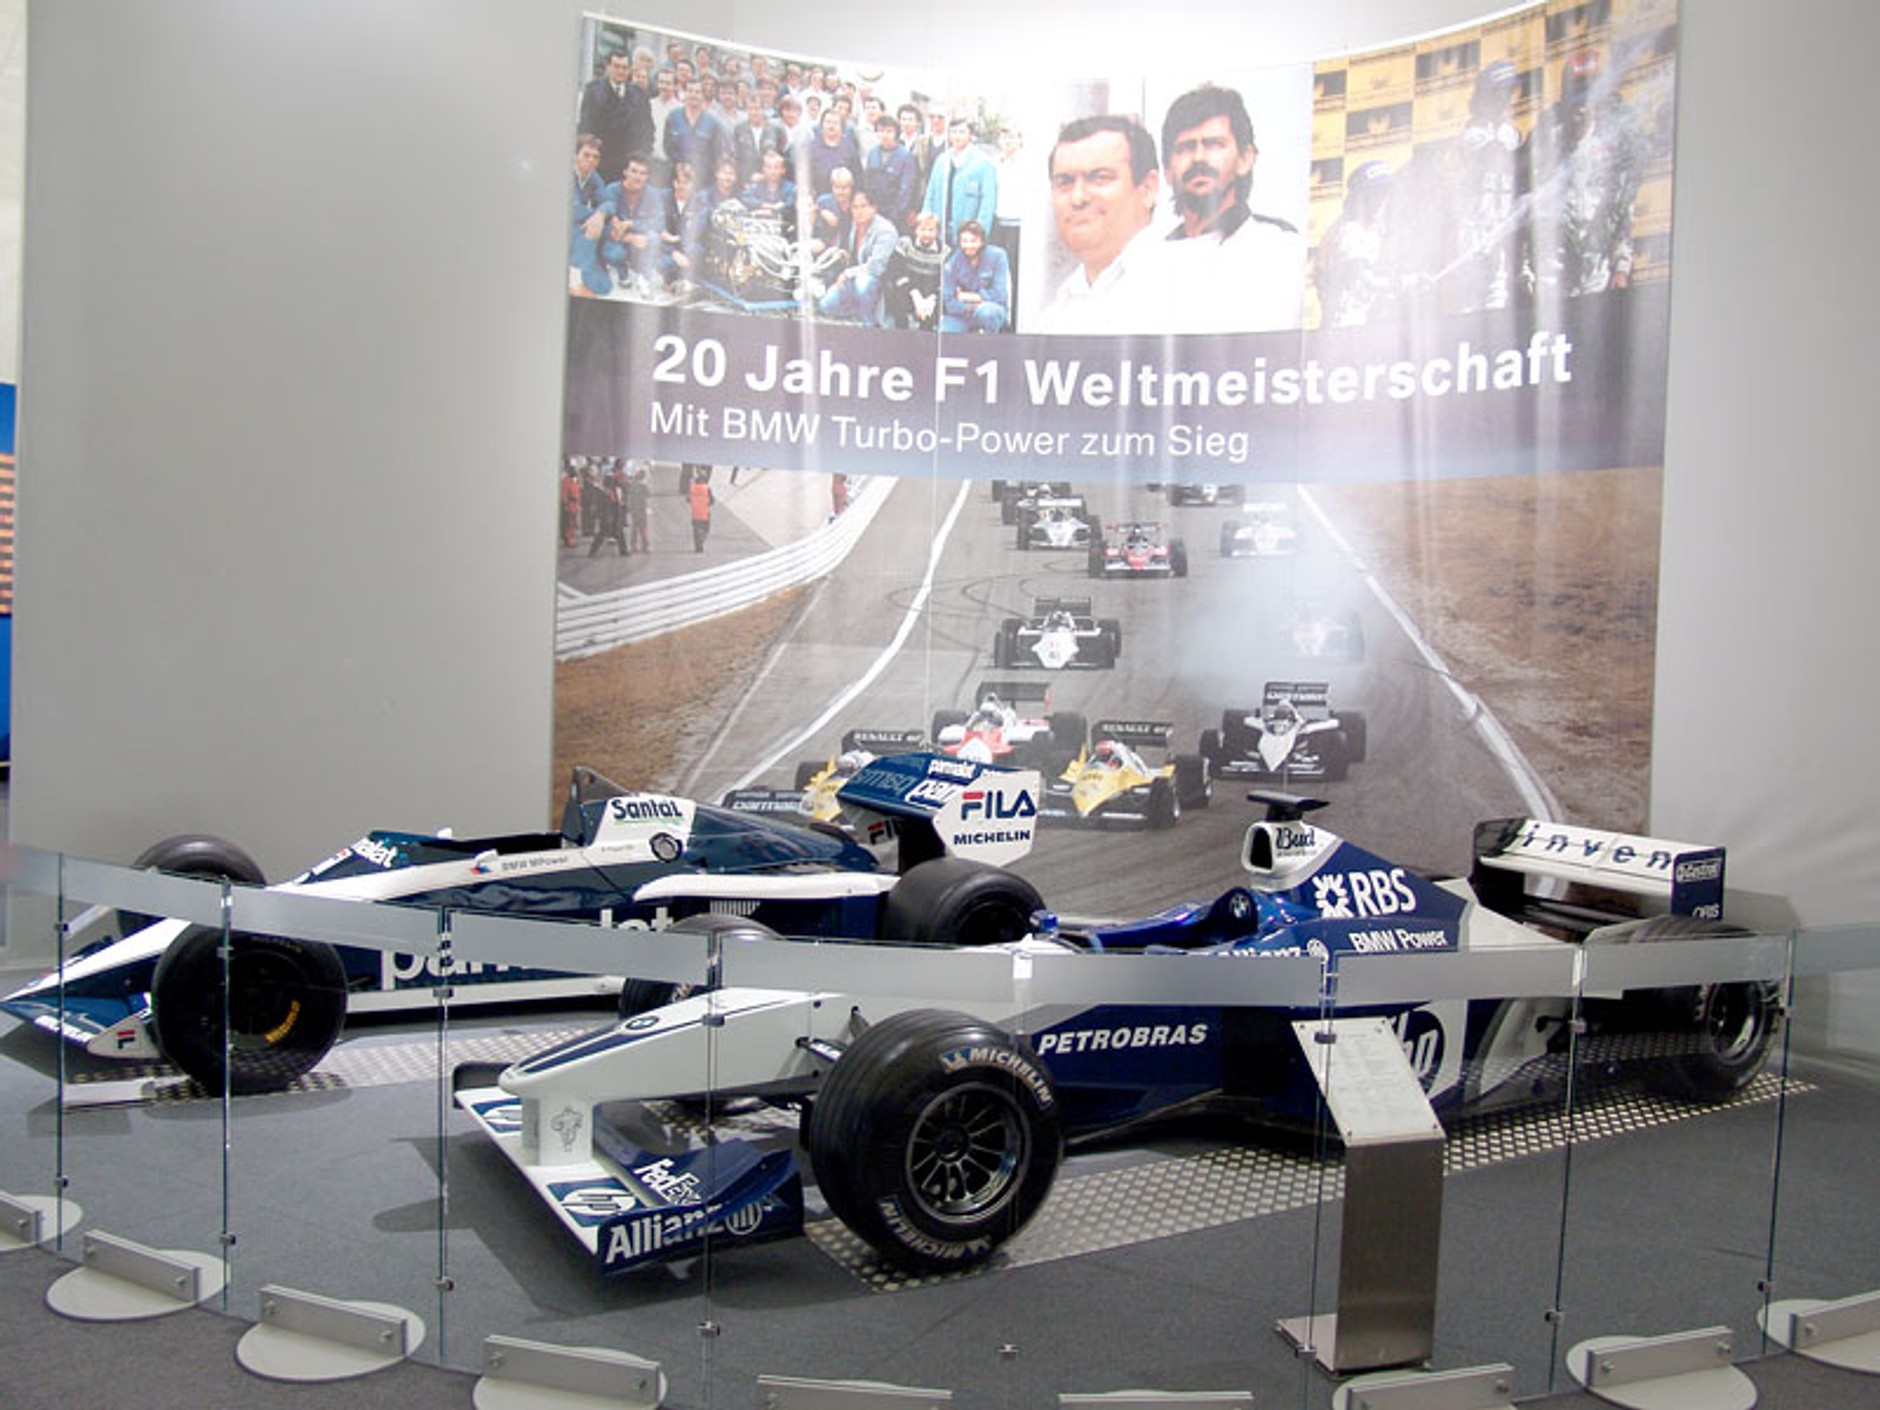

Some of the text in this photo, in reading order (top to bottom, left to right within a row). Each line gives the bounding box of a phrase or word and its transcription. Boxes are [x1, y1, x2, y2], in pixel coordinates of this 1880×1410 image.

[652, 330, 1572, 406] 20 Jahre F1 Weltmeisterschaft
[650, 401, 1248, 464] Mit BMW Turbo-Power zum Sieg
[961, 789, 1036, 821] FILA
[953, 829, 1031, 846] MICHELIN
[501, 860, 528, 872] BMW
[1348, 868, 1416, 917] RBS
[1348, 928, 1448, 952] BMW Power
[1037, 1023, 1209, 1057] PETROBRAS
[968, 1047, 1055, 1111] MICHELIN
[633, 1157, 702, 1206] FedEx
[604, 1202, 724, 1265] Allianz
